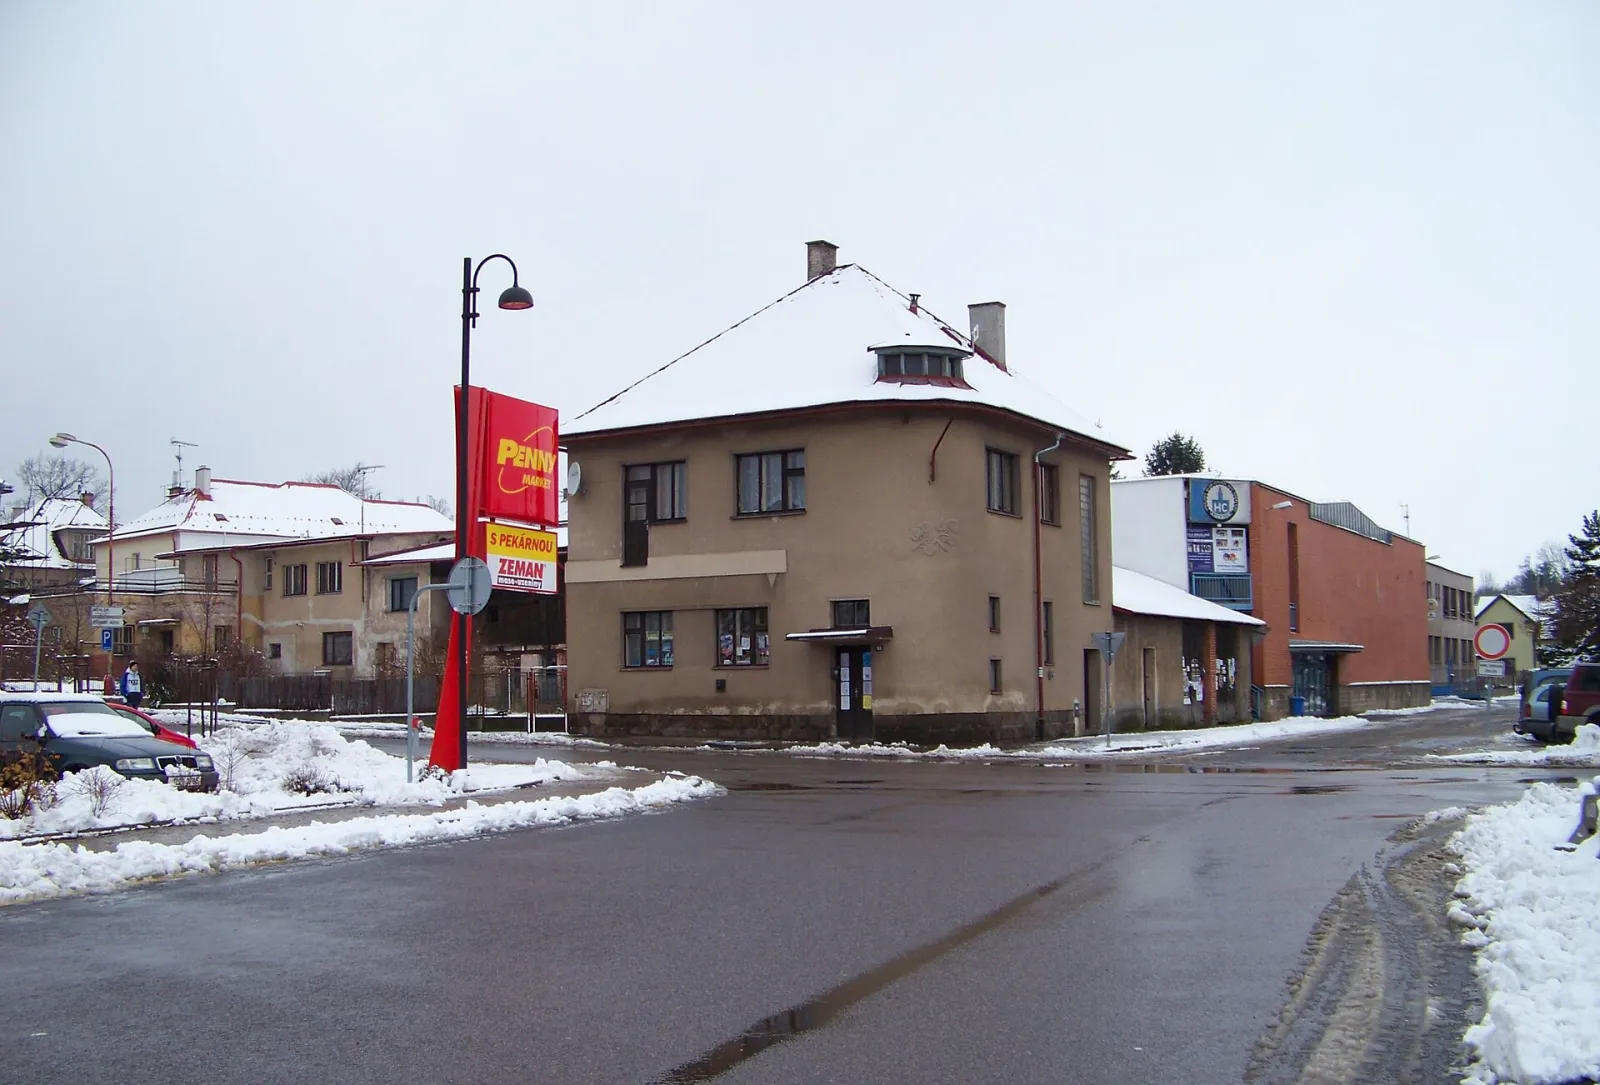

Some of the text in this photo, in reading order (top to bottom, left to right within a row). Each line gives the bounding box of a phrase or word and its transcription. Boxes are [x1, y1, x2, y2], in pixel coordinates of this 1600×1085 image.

[497, 438, 556, 474] PENNY
[522, 474, 551, 489] MARKET
[1213, 502, 1228, 513] HC
[490, 532, 553, 553] S PEKÁRNOU
[498, 558, 544, 579] ZEMAN
[103, 631, 111, 645] P
